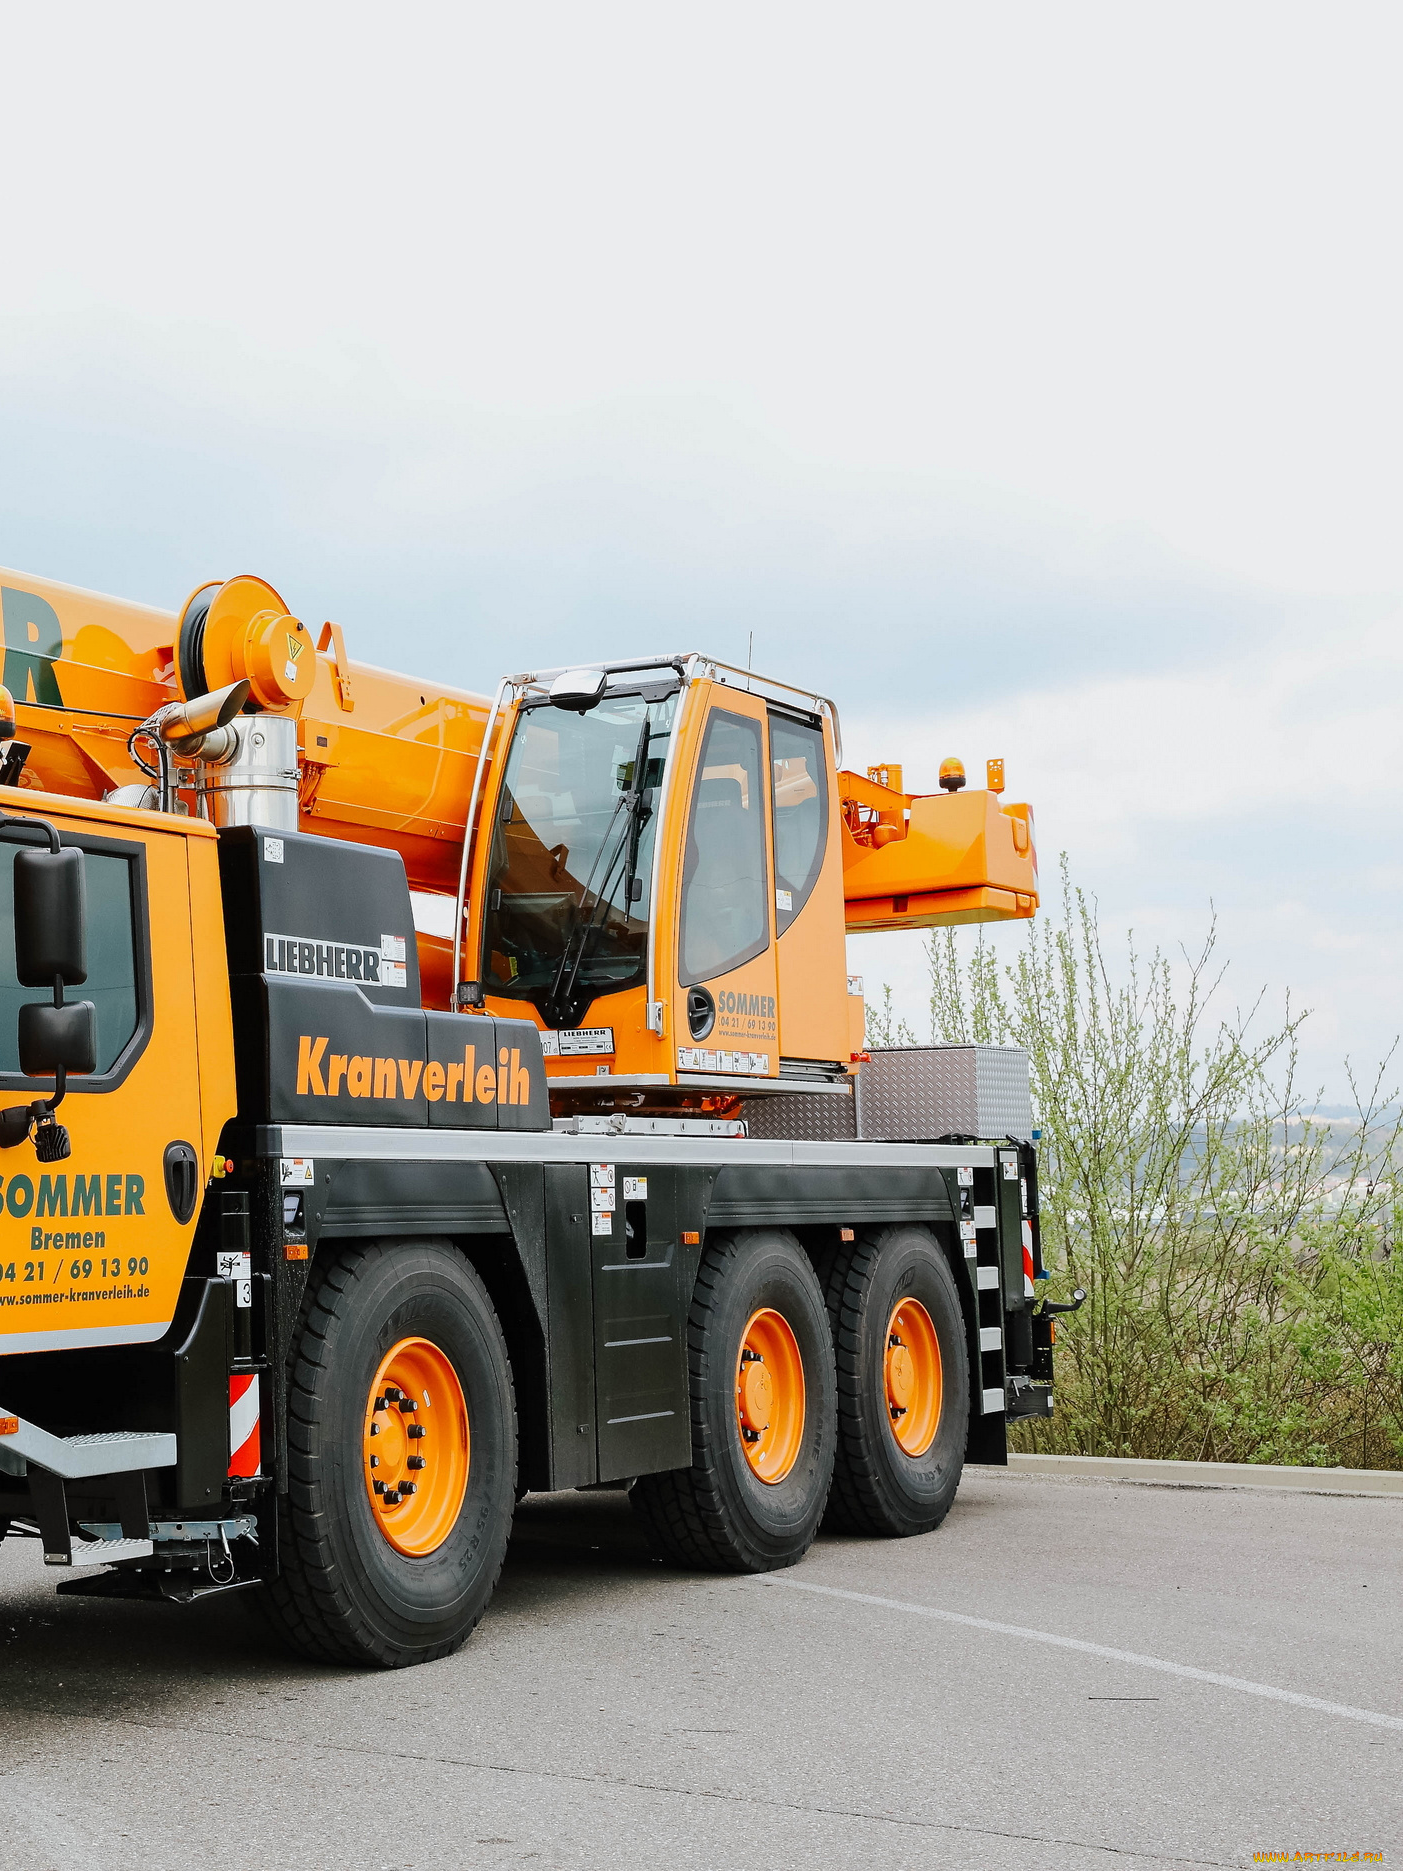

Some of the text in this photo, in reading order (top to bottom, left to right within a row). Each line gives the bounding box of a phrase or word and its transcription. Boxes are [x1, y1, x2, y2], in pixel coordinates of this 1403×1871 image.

[267, 937, 380, 983] LIEBHERR
[718, 990, 776, 1019] SOMMER
[563, 1029, 606, 1037] LIEBHERR
[731, 1017, 739, 1028] 21
[747, 1019, 756, 1030] 69
[758, 1020, 766, 1031] 13
[767, 1021, 776, 1032] 90
[296, 1035, 530, 1106] Kranverleih
[30, 1226, 106, 1251] Bremen
[23, 1260, 45, 1282] 21
[52, 1258, 64, 1285] /
[69, 1258, 93, 1280] 69
[100, 1257, 121, 1278] 13
[127, 1256, 149, 1277] 90
